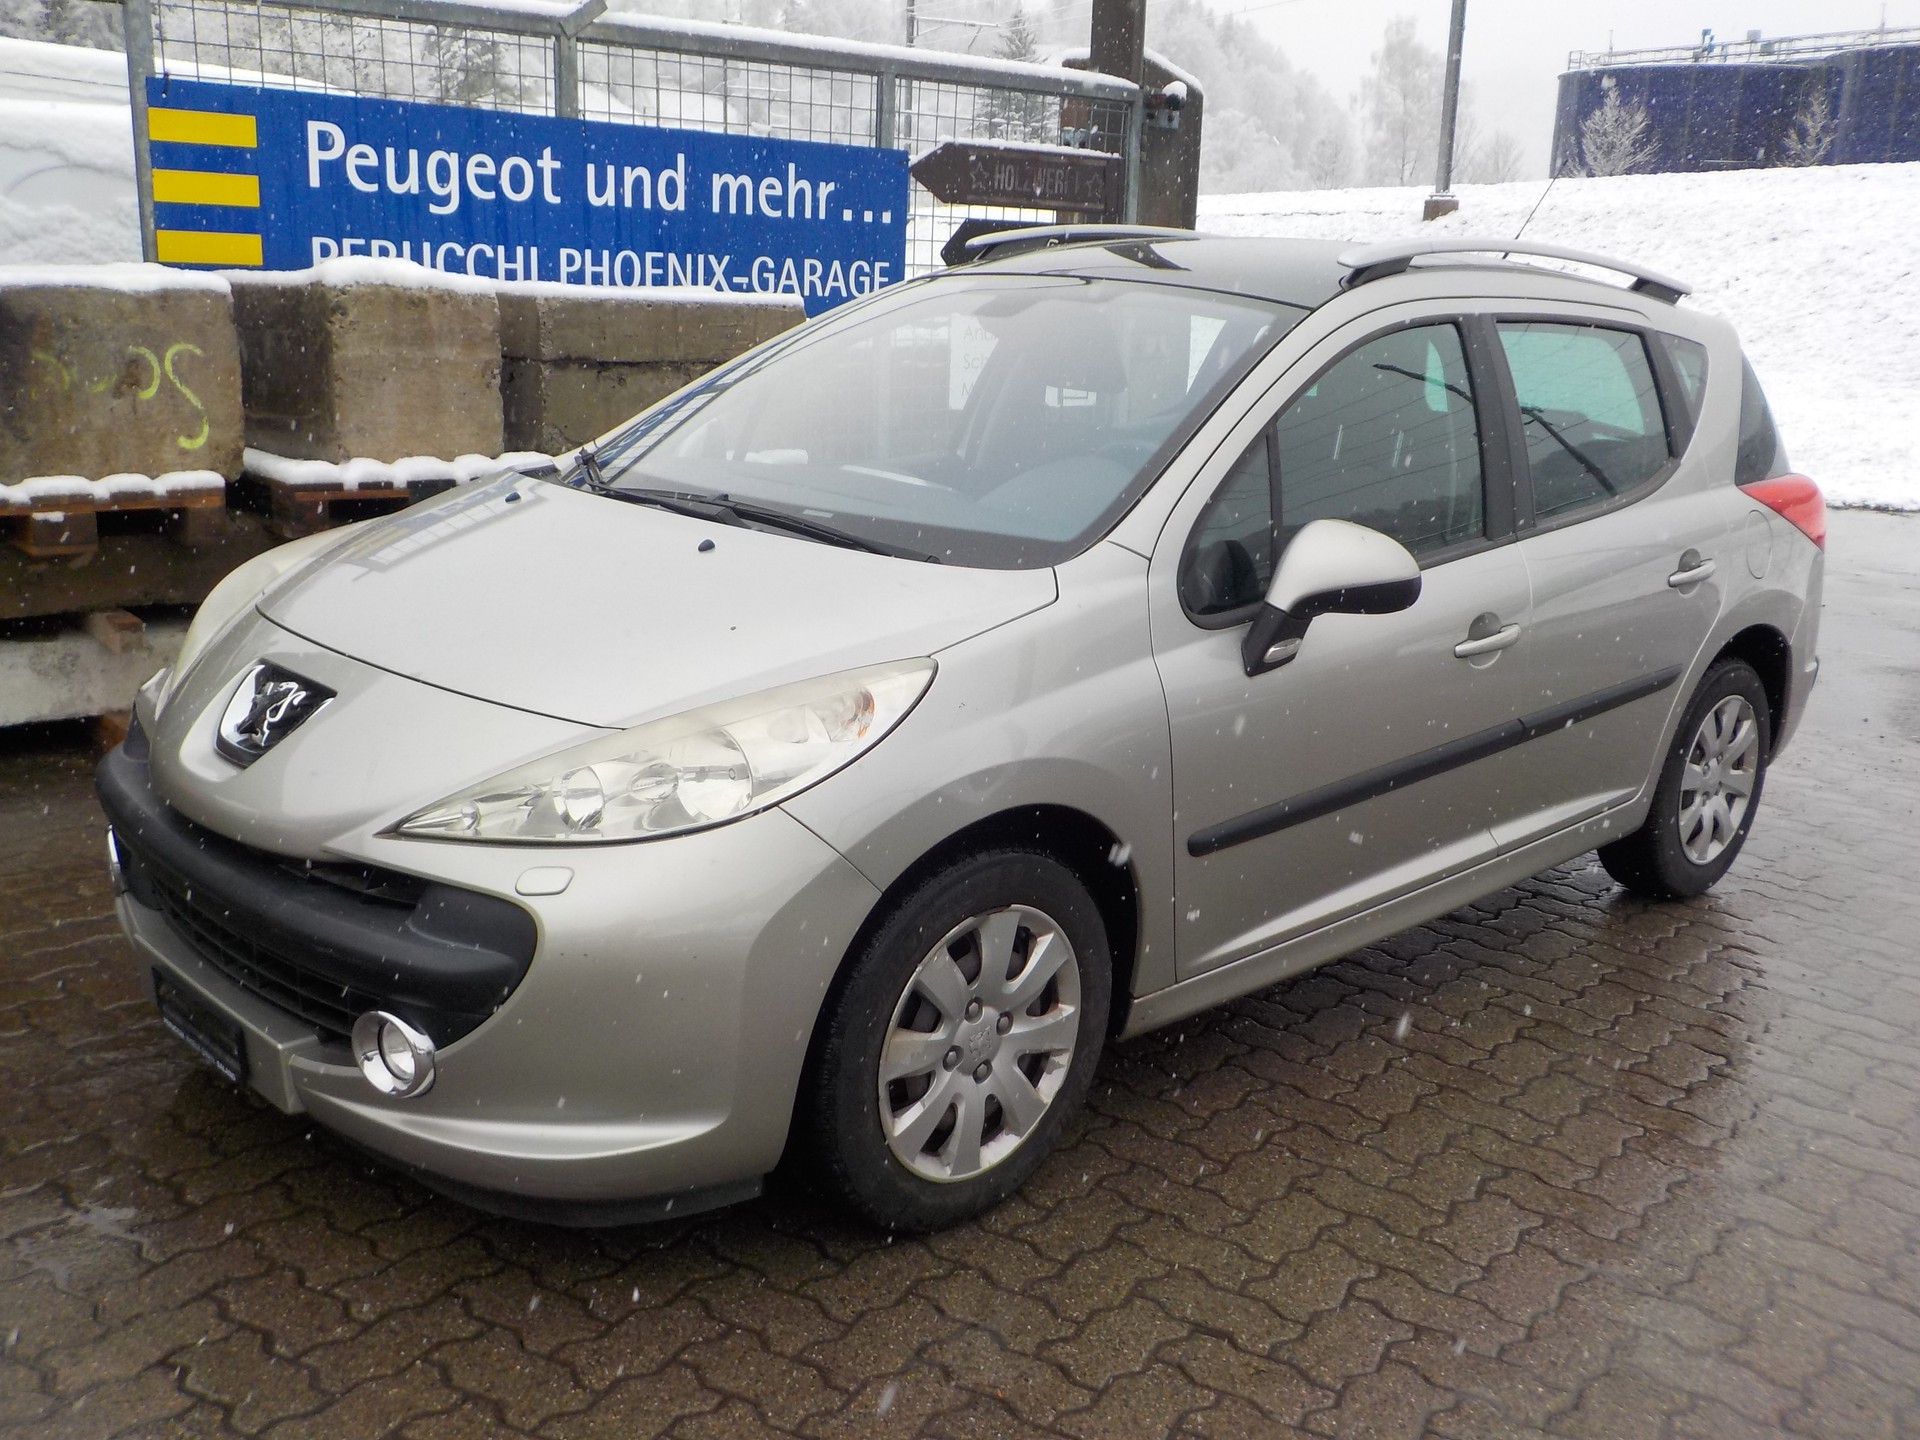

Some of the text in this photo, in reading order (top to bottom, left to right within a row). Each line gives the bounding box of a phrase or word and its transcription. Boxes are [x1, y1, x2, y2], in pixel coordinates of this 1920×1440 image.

[306, 119, 892, 224] Peugeot und mehr...
[559, 247, 890, 298] PHOENIX-GARAGE
